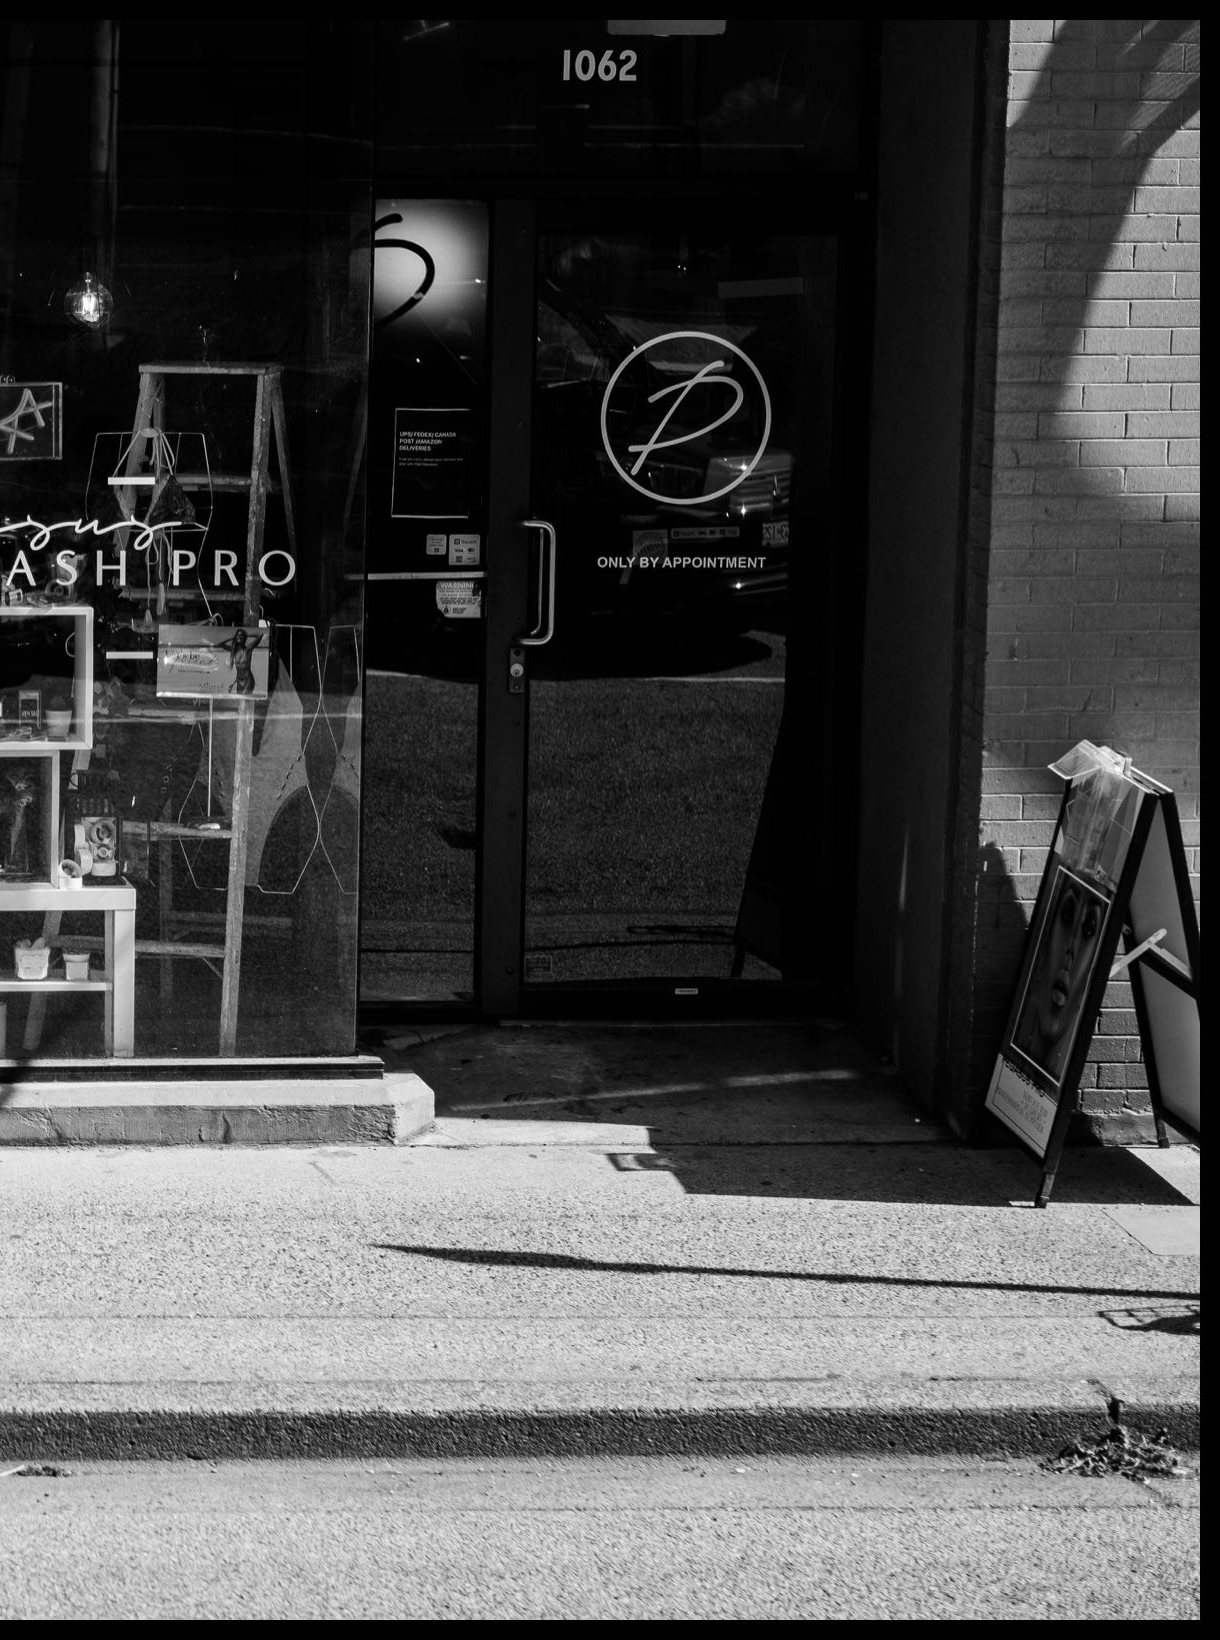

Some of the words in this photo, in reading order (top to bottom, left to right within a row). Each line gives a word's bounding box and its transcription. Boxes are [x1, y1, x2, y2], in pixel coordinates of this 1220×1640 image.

[563, 50, 637, 82] 1062
[172, 549, 296, 587] PRO
[596, 556, 636, 569] ONLY
[639, 556, 660, 569] BY
[661, 556, 767, 569] APPOINTMENT
